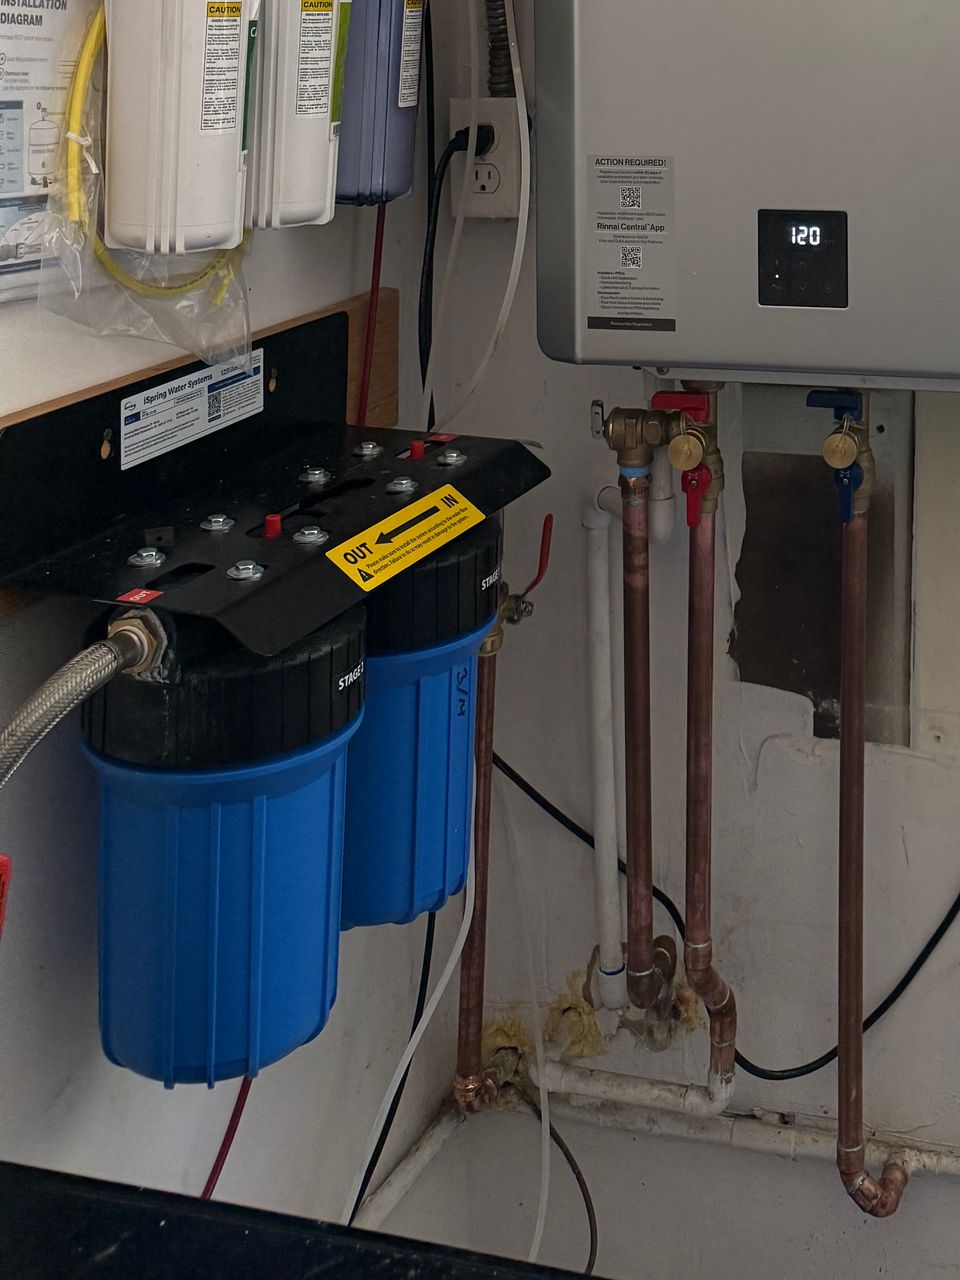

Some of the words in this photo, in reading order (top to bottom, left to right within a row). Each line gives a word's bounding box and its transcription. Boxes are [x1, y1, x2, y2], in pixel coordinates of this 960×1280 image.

[209, 6, 241, 14] CAUTION
[0, 13, 43, 26] DIAGRAM
[624, 159, 666, 167] REQUIRED!
[596, 222, 620, 230] Rinnai
[649, 224, 665, 233] App
[791, 226, 820, 245] 120
[143, 392, 167, 405] iSpring
[167, 383, 187, 396] Water
[187, 374, 213, 389] Systems
[441, 493, 459, 508] IN
[343, 542, 374, 565] OUT
[338, 664, 361, 690] STAGE
